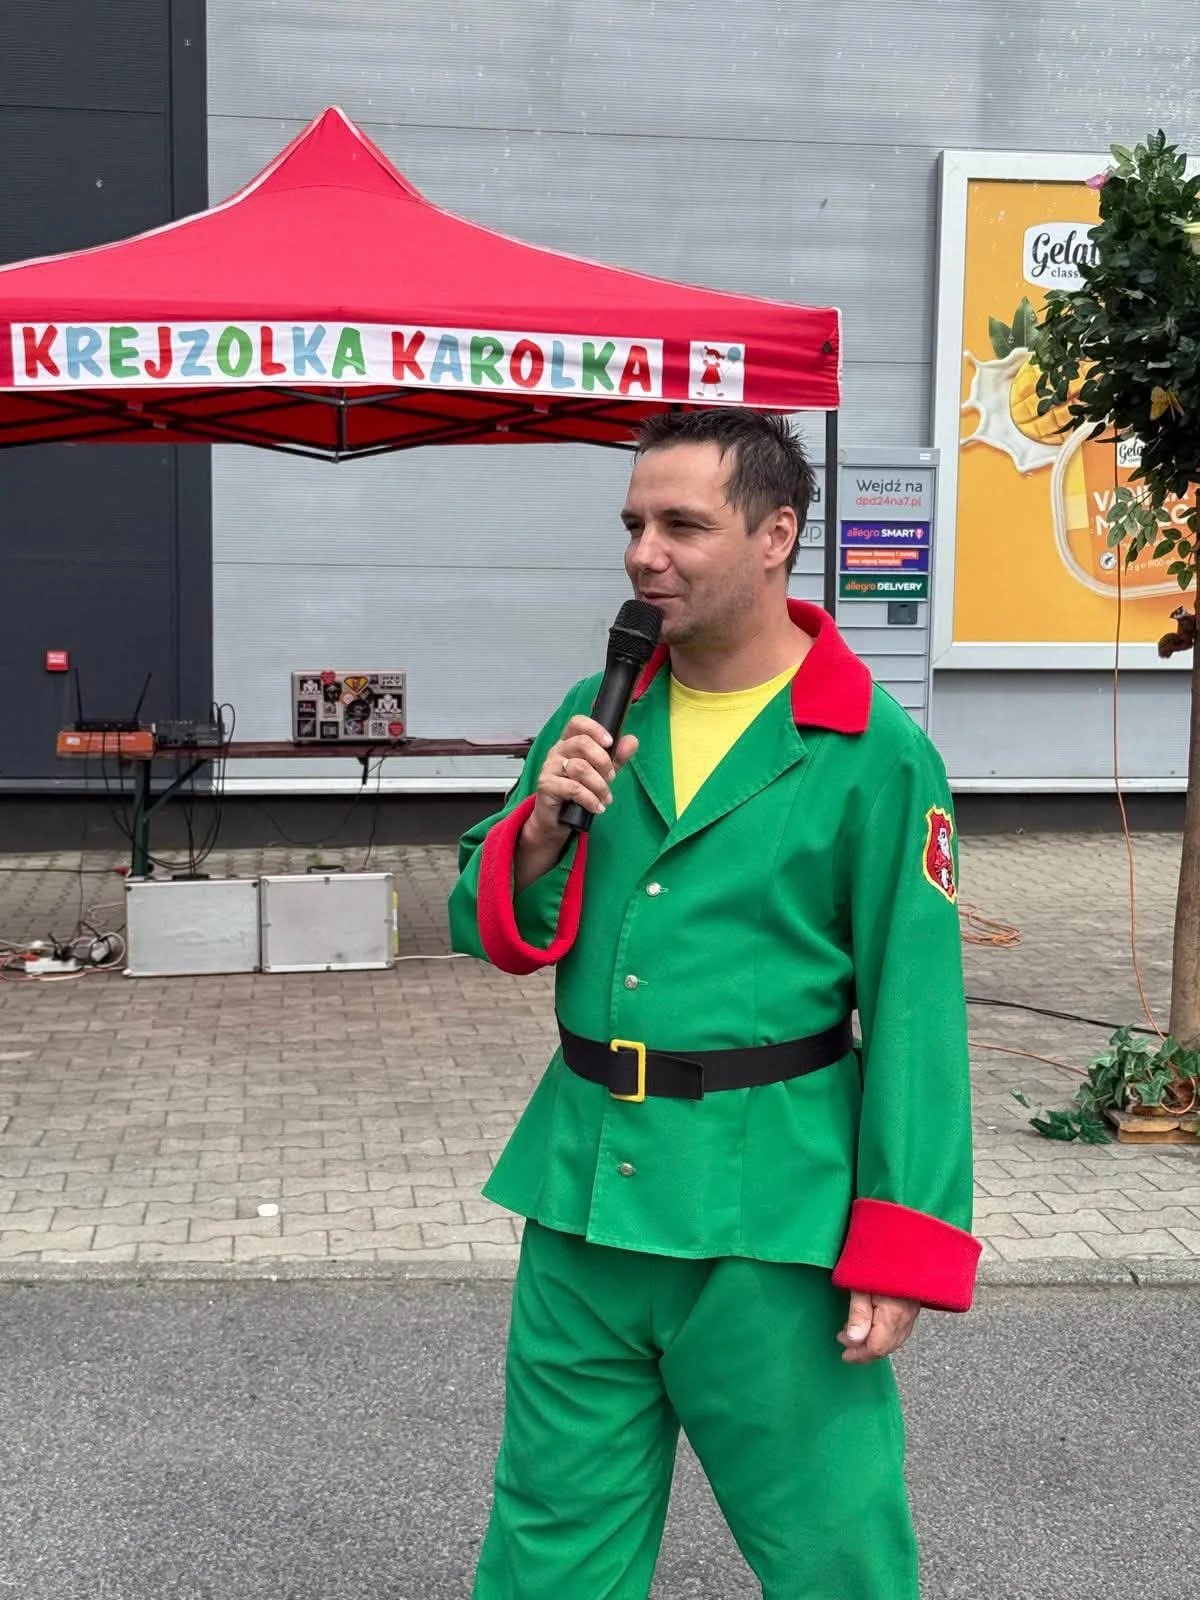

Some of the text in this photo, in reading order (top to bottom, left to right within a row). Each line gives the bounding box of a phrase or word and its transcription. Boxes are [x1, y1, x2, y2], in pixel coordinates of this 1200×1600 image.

[1051, 267, 1079, 277] class
[22, 324, 652, 395] KREJZOLKA KAROLKA
[856, 479, 923, 494] Wejdź na
[856, 496, 922, 506] dpd24na7.pl
[847, 528, 915, 539] allegro SMART
[846, 580, 922, 592] allegro DELIVERY
